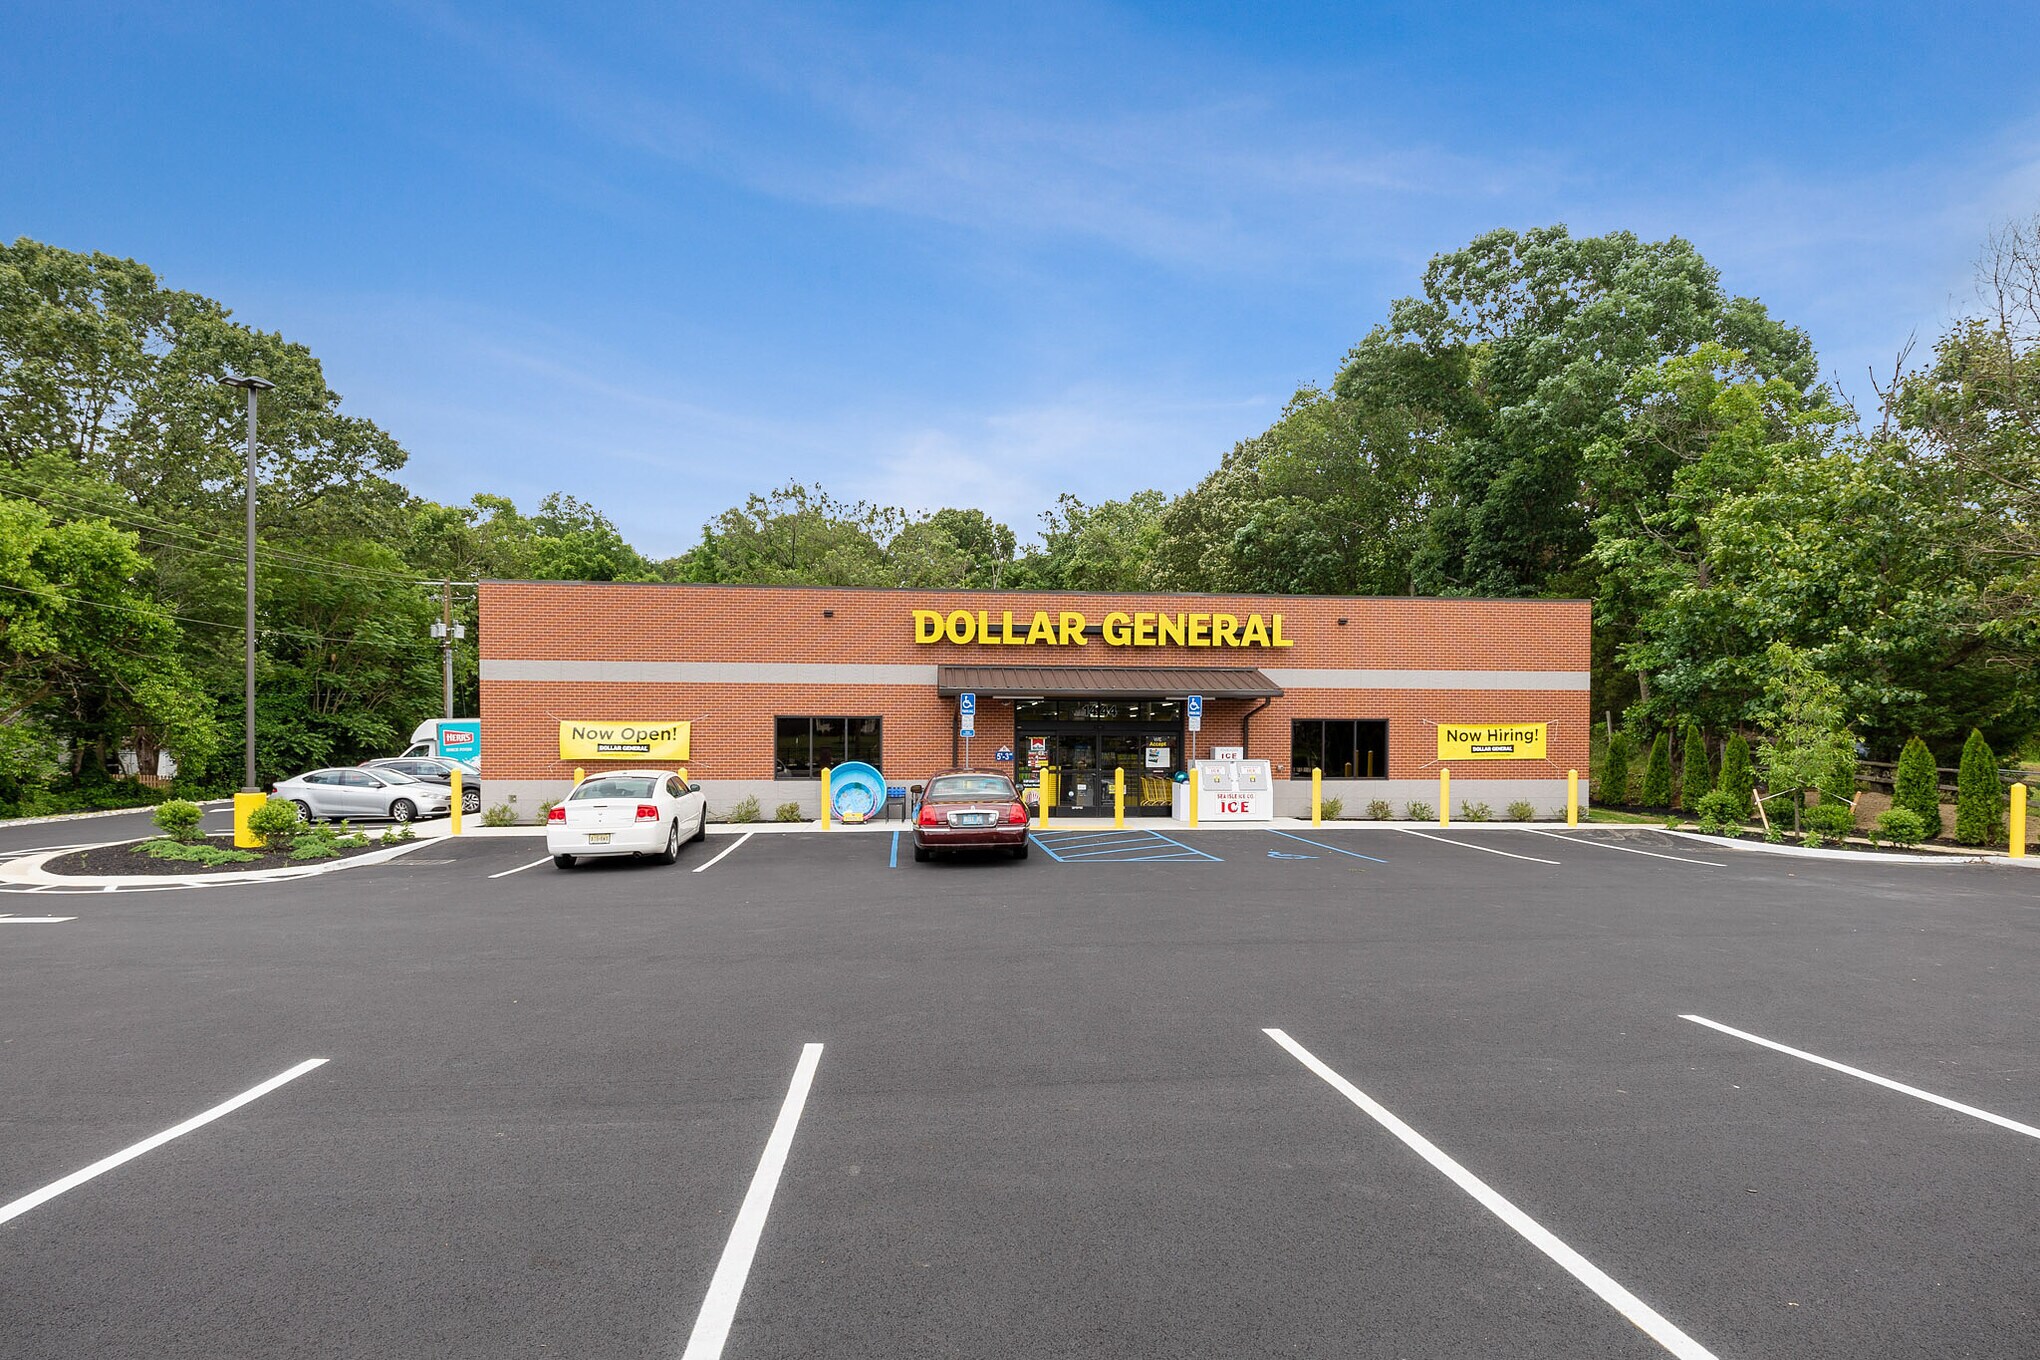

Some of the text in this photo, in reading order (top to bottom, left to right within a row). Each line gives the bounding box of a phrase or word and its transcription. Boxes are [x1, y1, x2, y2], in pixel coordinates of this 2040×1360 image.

[912, 610, 1294, 647] DOLLAR GENERAL
[1083, 704, 1117, 717] 1444
[572, 727, 677, 743] Now Open!
[1447, 729, 1539, 744] Now Hiring!
[1221, 752, 1238, 760] ICE
[1221, 801, 1249, 813] ICE
